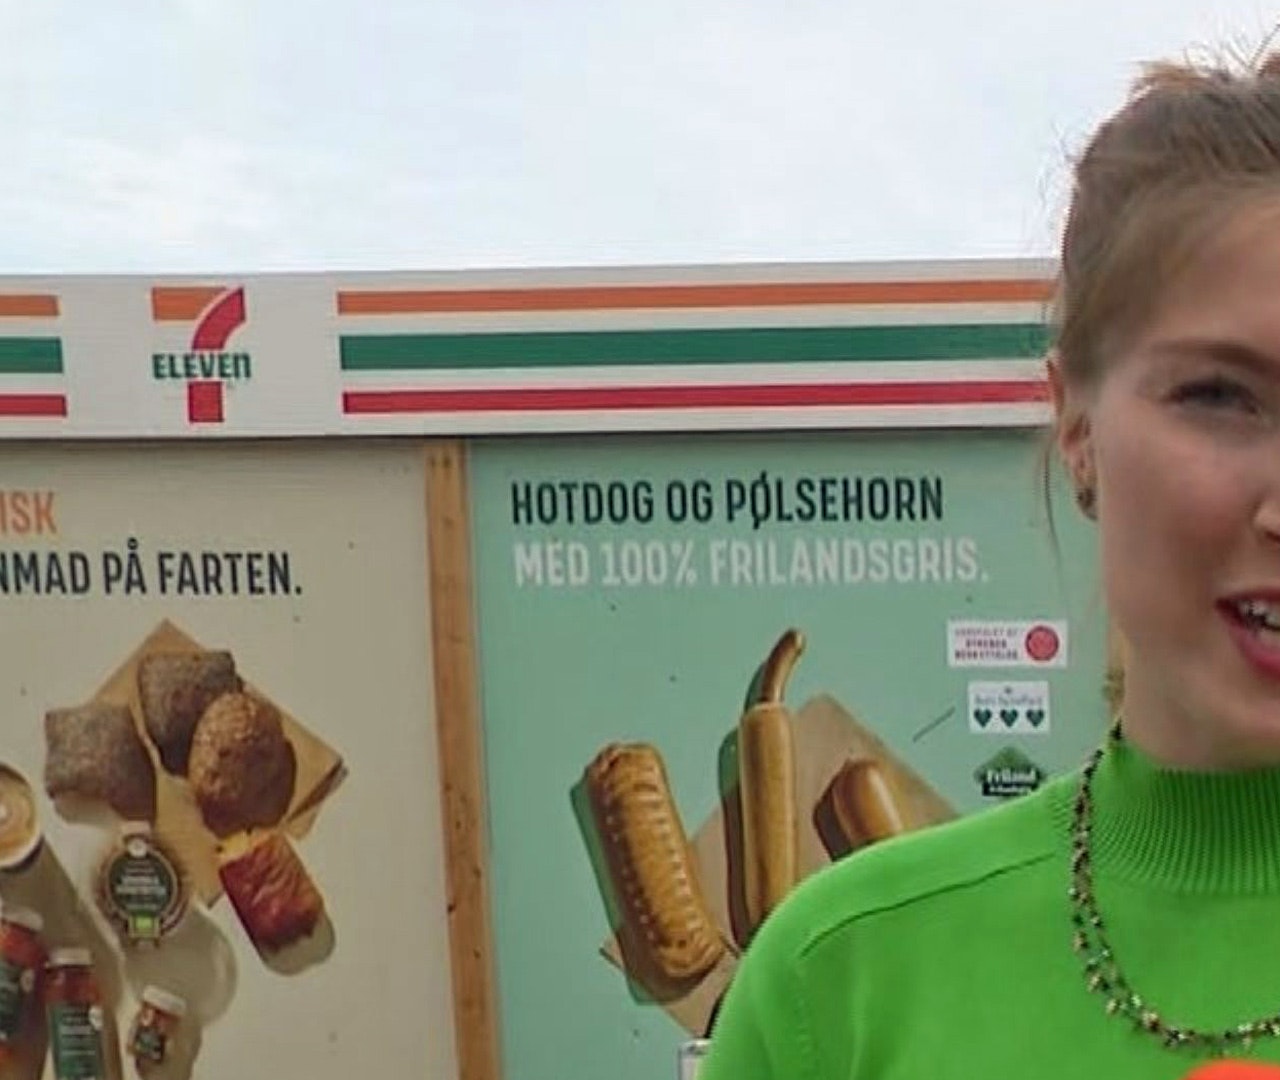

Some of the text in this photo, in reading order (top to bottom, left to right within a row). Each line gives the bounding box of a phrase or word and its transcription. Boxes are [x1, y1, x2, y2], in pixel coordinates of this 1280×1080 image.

[511, 470, 944, 530] HOTDOG OG PØLSEHORN
[103, 537, 147, 595] PÅ
[158, 552, 302, 596] FARTEN.
[514, 535, 989, 587] MED 100% FRILANDSGRIS.
